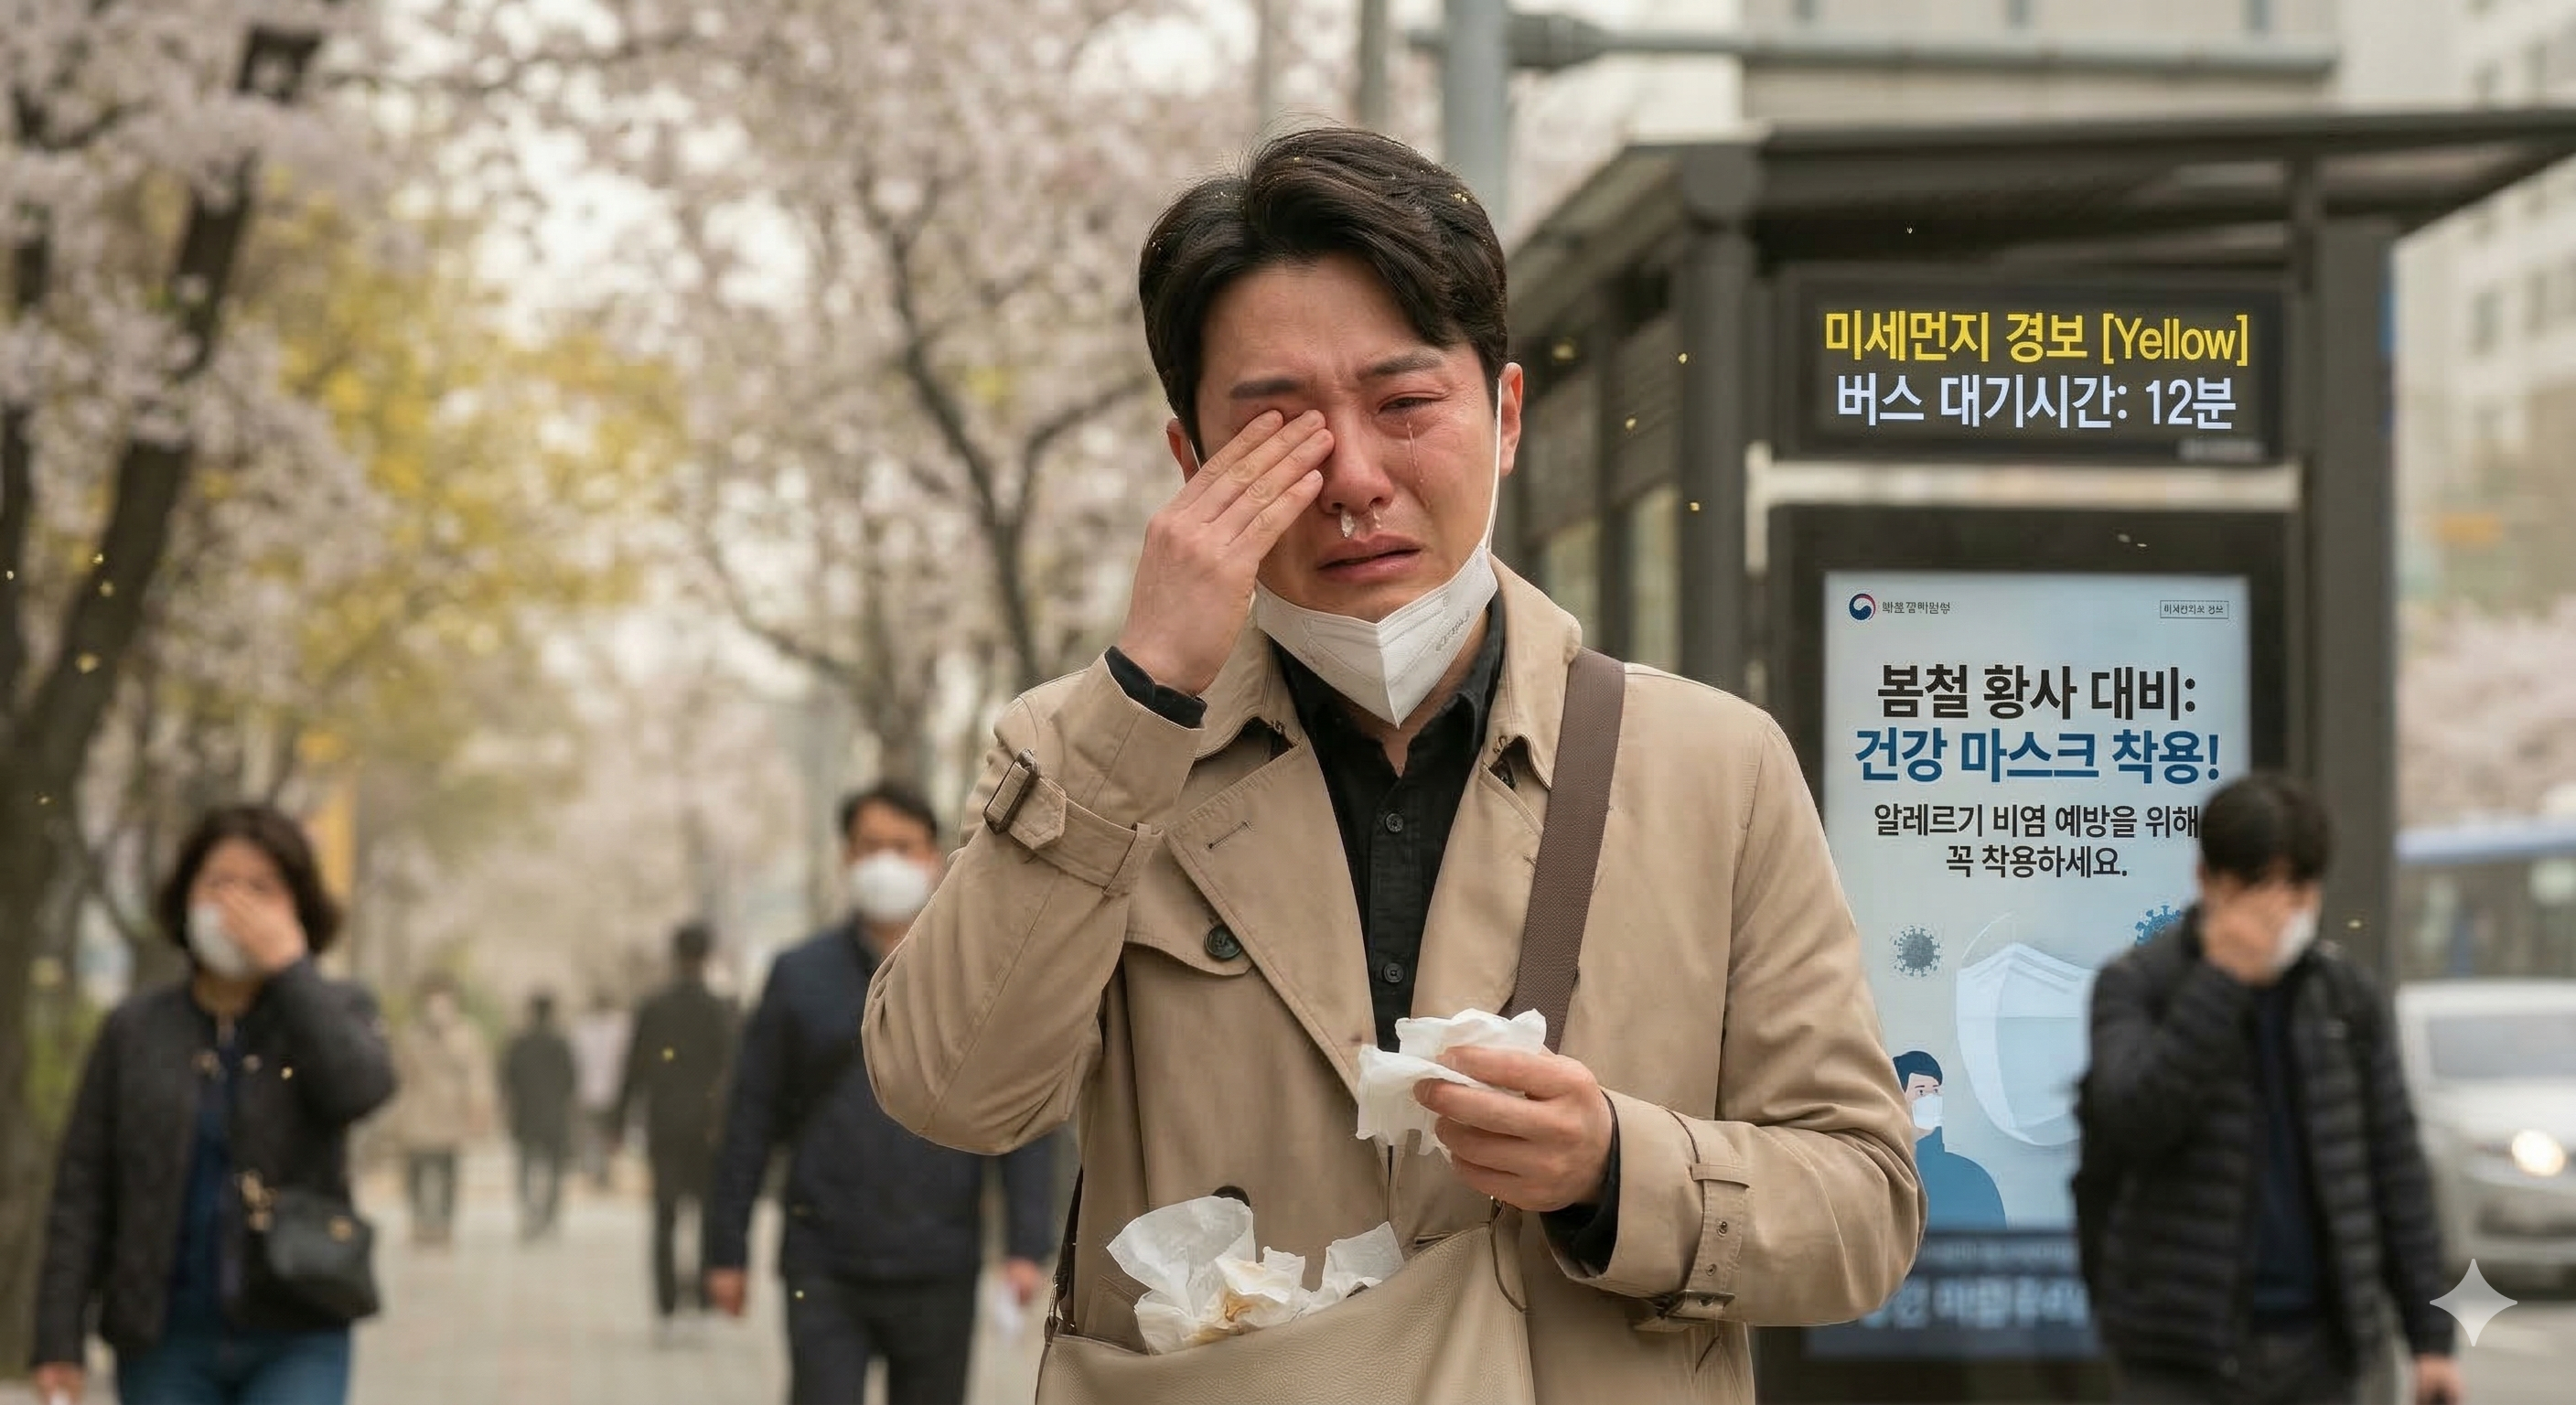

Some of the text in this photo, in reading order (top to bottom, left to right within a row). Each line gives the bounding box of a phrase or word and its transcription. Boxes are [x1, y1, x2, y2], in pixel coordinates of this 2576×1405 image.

[1827, 310, 2249, 366] 미세먼지 경보 [Yellow]
[1838, 372, 2237, 430] 버스 대기시간: 12분
[1877, 663, 2195, 721] 봄철 황사 대비:
[1855, 726, 2220, 785] 건강 마스크 착용!
[1874, 803, 2198, 839] 알레르기 비염 예방을 위해
[1946, 844, 2128, 879] 꼭 착용하세요.
